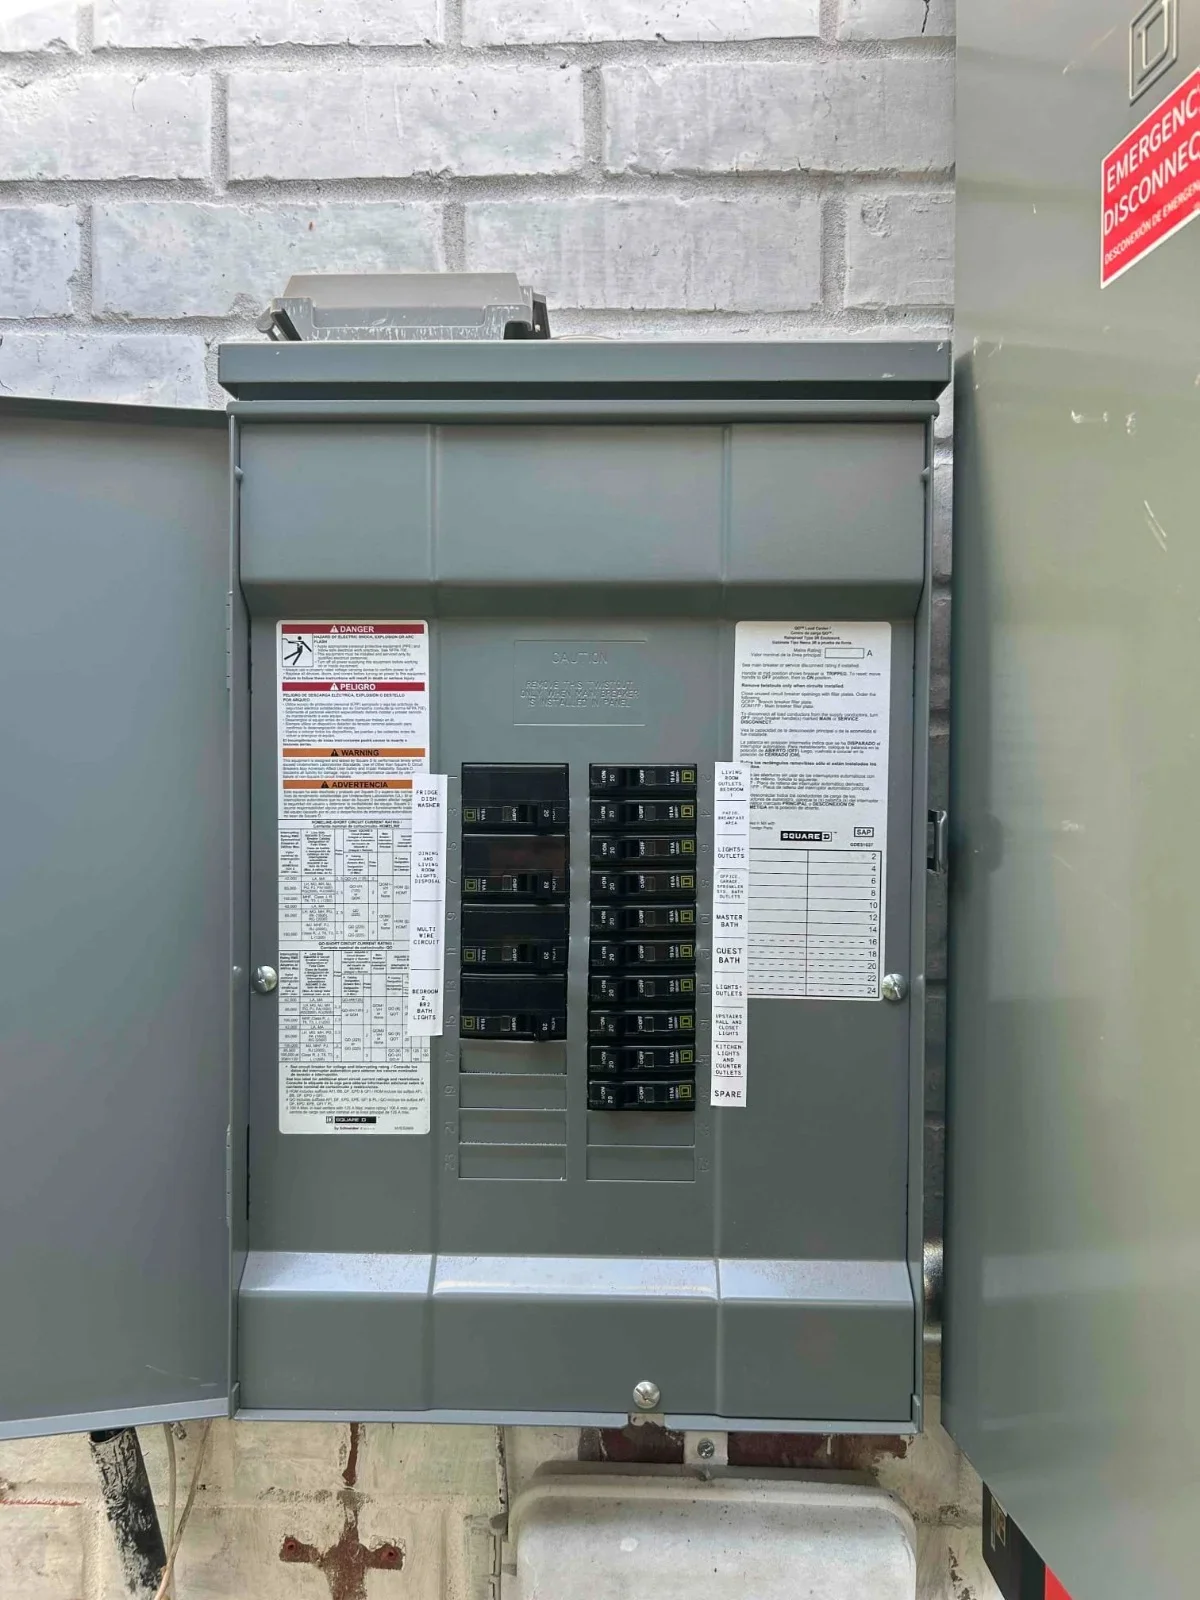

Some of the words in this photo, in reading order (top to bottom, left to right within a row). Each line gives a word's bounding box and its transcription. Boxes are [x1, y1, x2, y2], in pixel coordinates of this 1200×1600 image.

[1107, 84, 1200, 193] EMERGENC
[1152, 209, 1163, 227] DE
[340, 625, 375, 633] DANGER
[866, 649, 873, 657] A
[340, 683, 376, 691] PELIGRO
[341, 749, 380, 757] WARNING
[610, 774, 615, 782] 20
[332, 781, 389, 789] ADVERTENCIA
[543, 809, 549, 818] 20
[609, 810, 615, 818] 20
[782, 832, 821, 840] SQUARE
[609, 846, 616, 854] 20
[609, 882, 615, 890] 20
[871, 889, 876, 897] 8
[609, 917, 615, 926] 20
[543, 951, 549, 960] 20
[609, 953, 615, 961] 20
[609, 989, 614, 997] 20
[542, 1023, 548, 1031] 20
[608, 1024, 614, 1032] 20
[609, 1060, 614, 1068] 20
[714, 1090, 742, 1098] SPARE
[608, 1095, 613, 1104] 20
